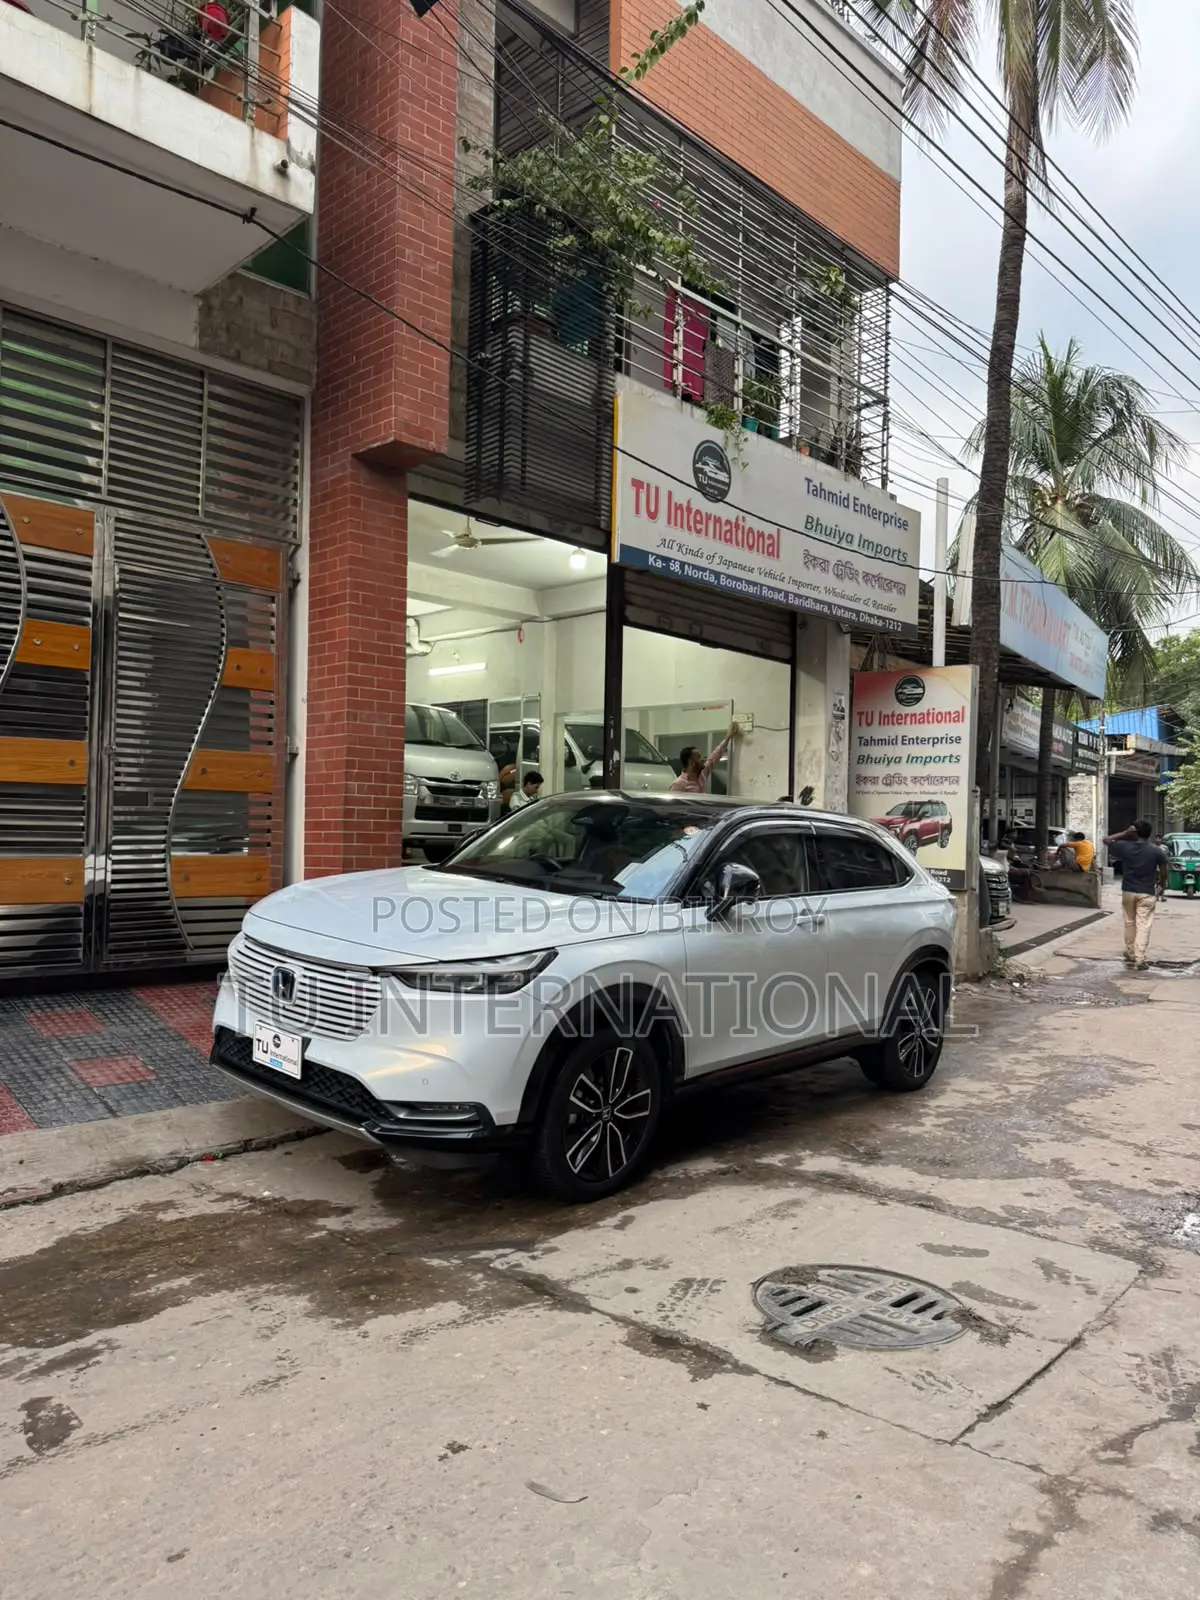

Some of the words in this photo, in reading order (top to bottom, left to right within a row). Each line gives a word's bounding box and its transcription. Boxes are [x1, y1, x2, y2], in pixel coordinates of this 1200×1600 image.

[630, 477, 660, 521] TU
[666, 490, 780, 559] International
[804, 476, 850, 509] Tahmid
[852, 496, 909, 532] Enterprise
[804, 515, 854, 545] Bhuiya
[858, 533, 909, 563] Imports
[656, 537, 676, 551] All
[676, 542, 704, 559] Kinds
[706, 552, 717, 564] of
[716, 555, 755, 574] Japanese
[757, 566, 785, 583] Vehicle
[787, 576, 821, 594] Importer,
[823, 586, 862, 604] Wholesaler
[872, 599, 898, 614] Retailer
[802, 549, 830, 574] ইকরা
[832, 559, 860, 585] ট্রেডিং
[648, 553, 667, 569] Ka-
[684, 564, 718, 585] Norda,
[720, 573, 760, 596] Borobari
[762, 586, 786, 604] Road,
[788, 593, 830, 614] Baridhara,
[832, 604, 858, 622] Vatara,
[860, 612, 903, 632] Dhaka-1212
[856, 710, 874, 728] TU
[878, 706, 965, 727] International
[856, 754, 902, 767] Bhuiya
[905, 753, 961, 766] Imports
[857, 735, 898, 747] Tahmid
[901, 733, 962, 748] Enterprise
[256, 1038, 269, 1054] TU
[270, 1049, 298, 1066] International
